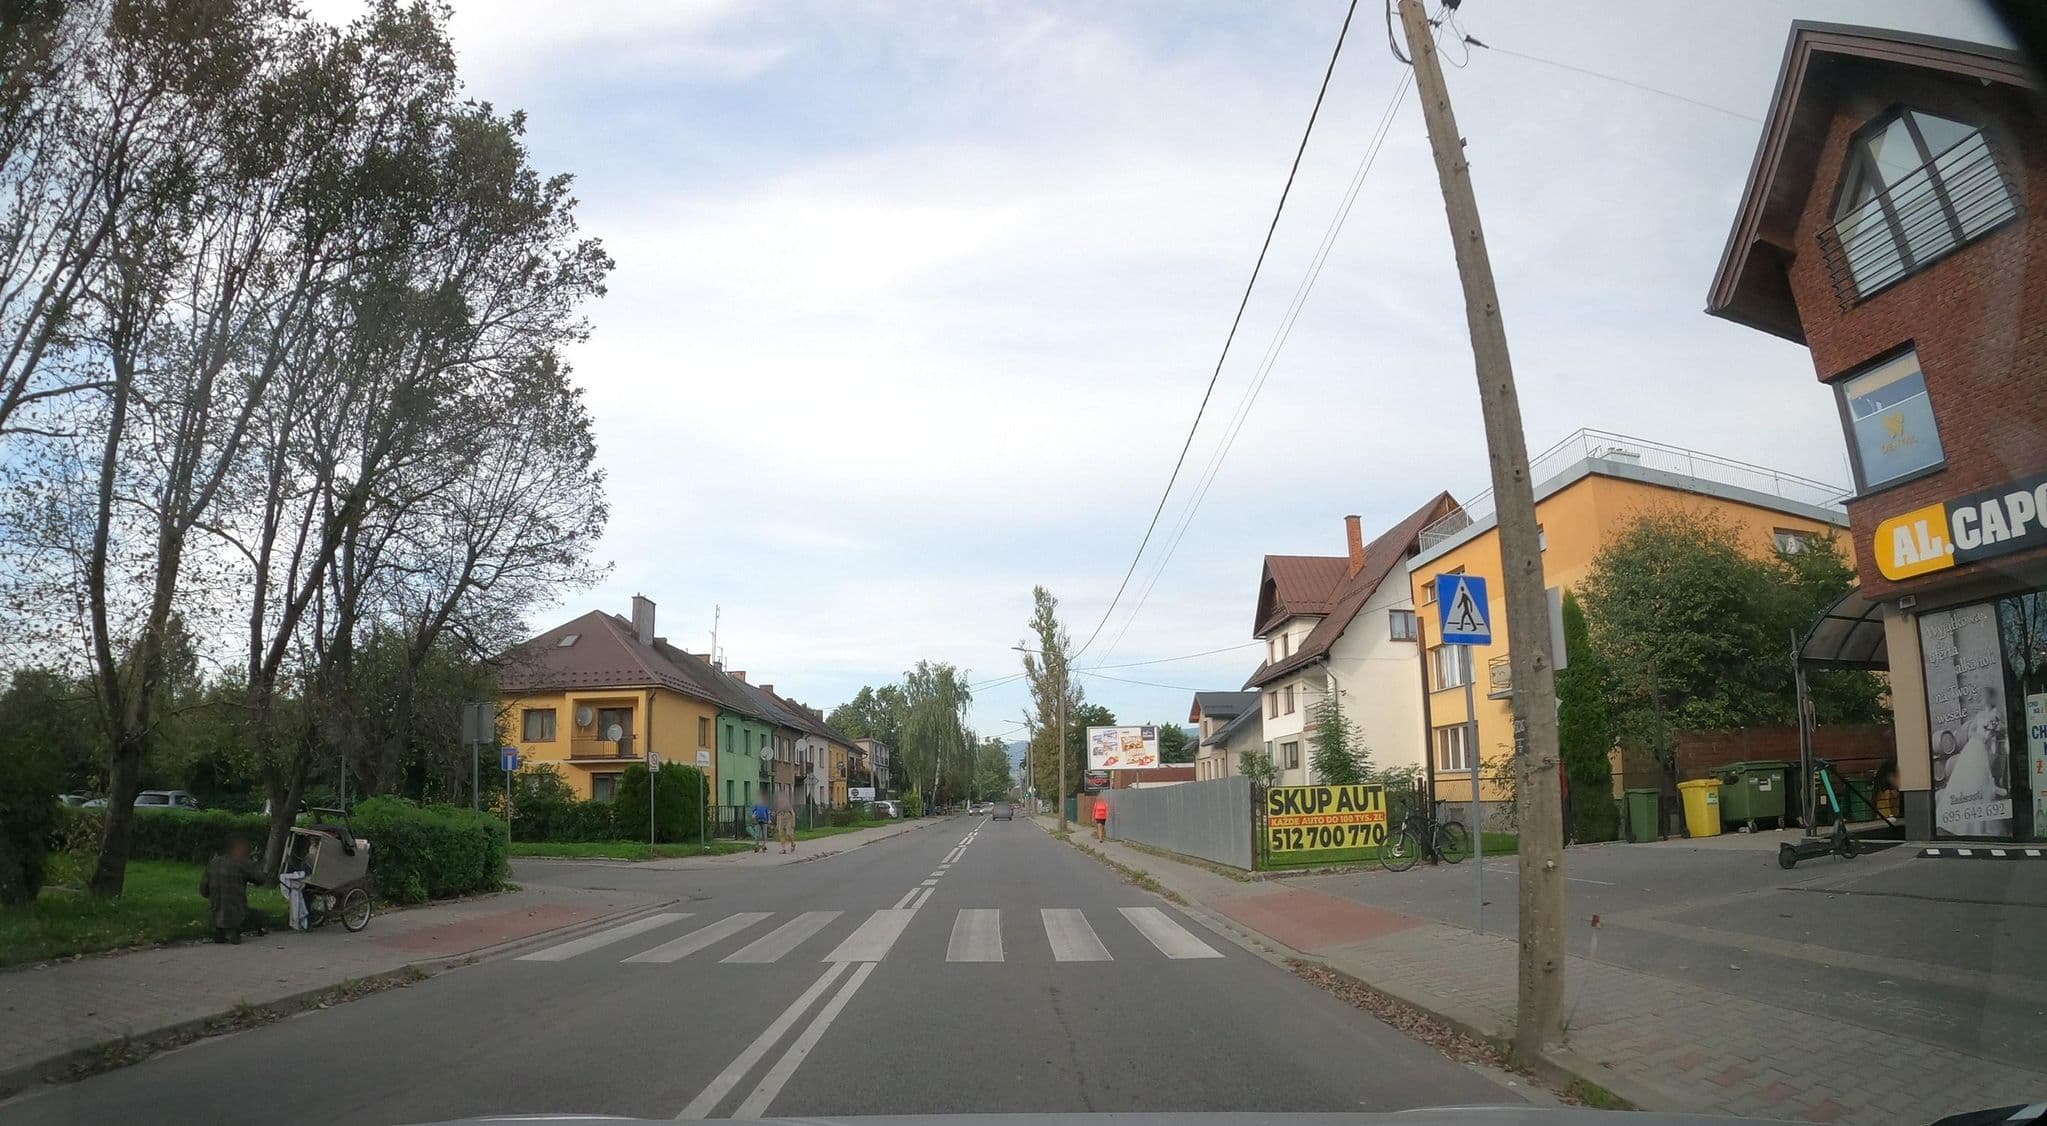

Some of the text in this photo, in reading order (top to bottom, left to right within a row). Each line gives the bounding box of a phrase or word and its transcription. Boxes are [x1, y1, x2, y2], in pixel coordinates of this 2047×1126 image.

[1269, 785, 1382, 816] SKUP AUT
[1301, 815, 1325, 825] AUTO
[1326, 815, 1339, 825] DO
[1340, 814, 1354, 824] 100
[1942, 810, 1961, 824] 695
[1272, 823, 1385, 850] 512 700 770
